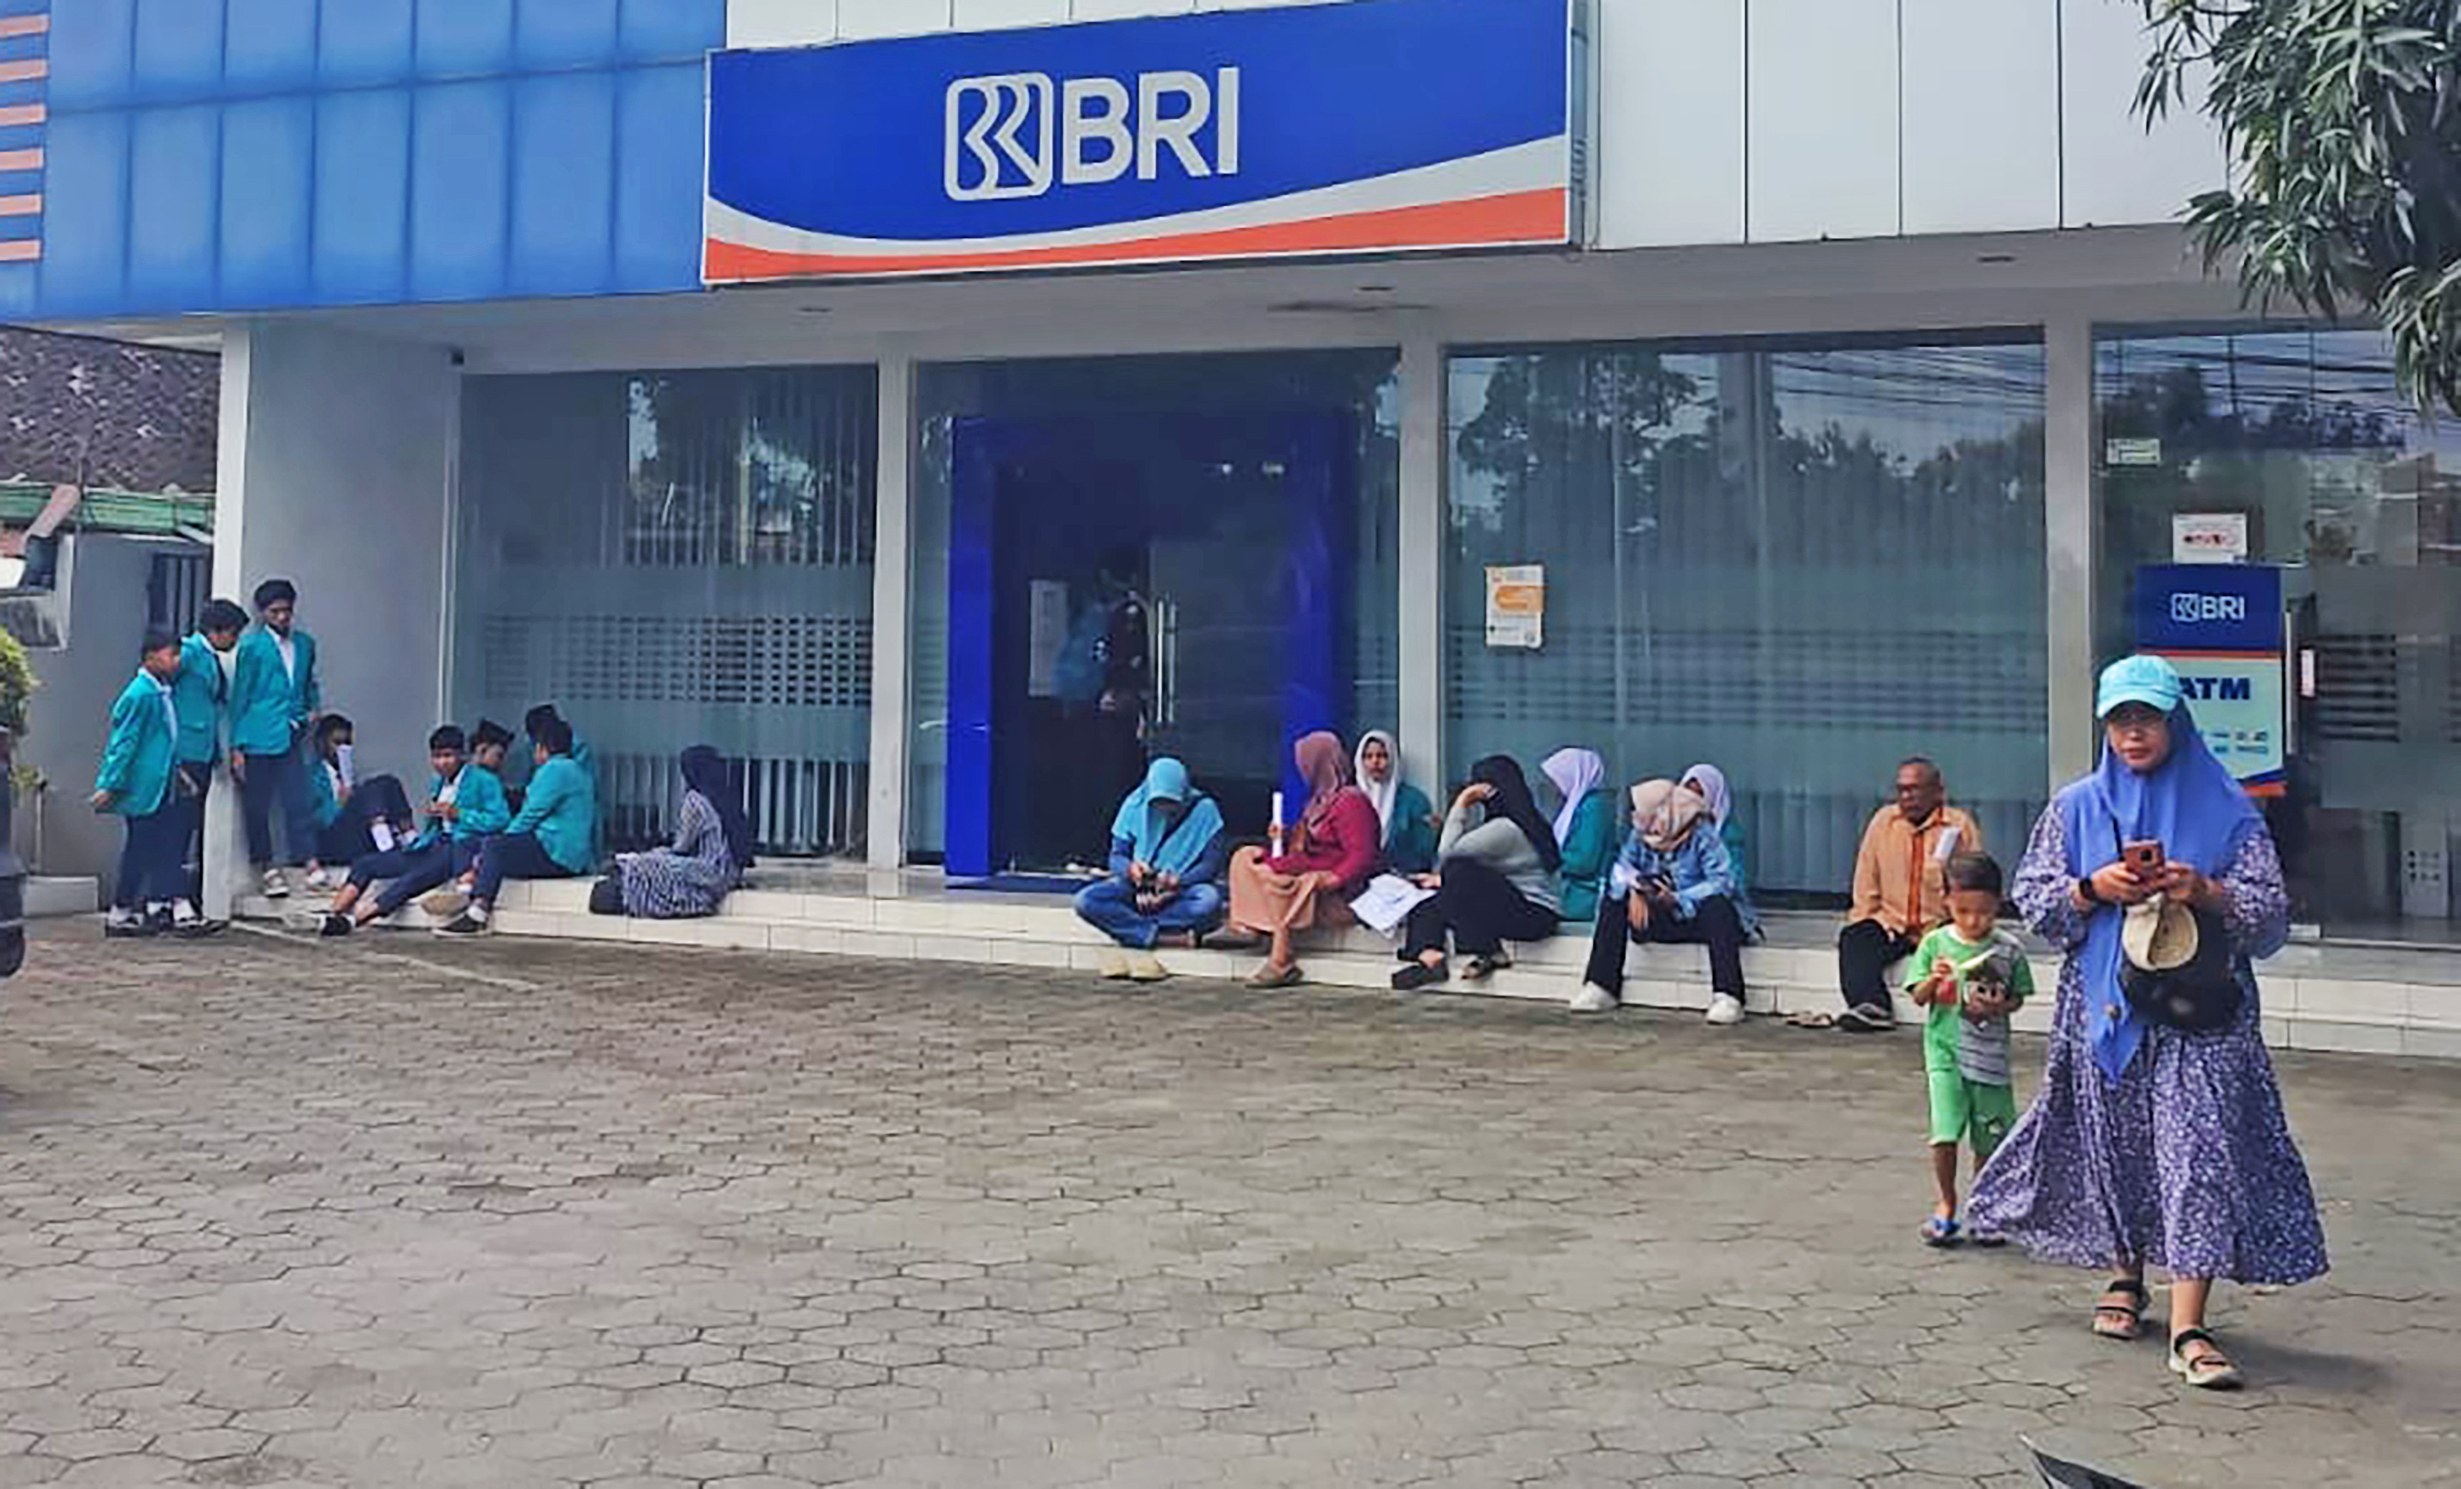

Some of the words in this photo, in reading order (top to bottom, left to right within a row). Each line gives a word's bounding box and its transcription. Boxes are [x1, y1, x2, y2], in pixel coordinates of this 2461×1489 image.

[1062, 67, 1239, 185] BRI
[2202, 595, 2245, 620] BRI
[2179, 677, 2250, 700] ATM
